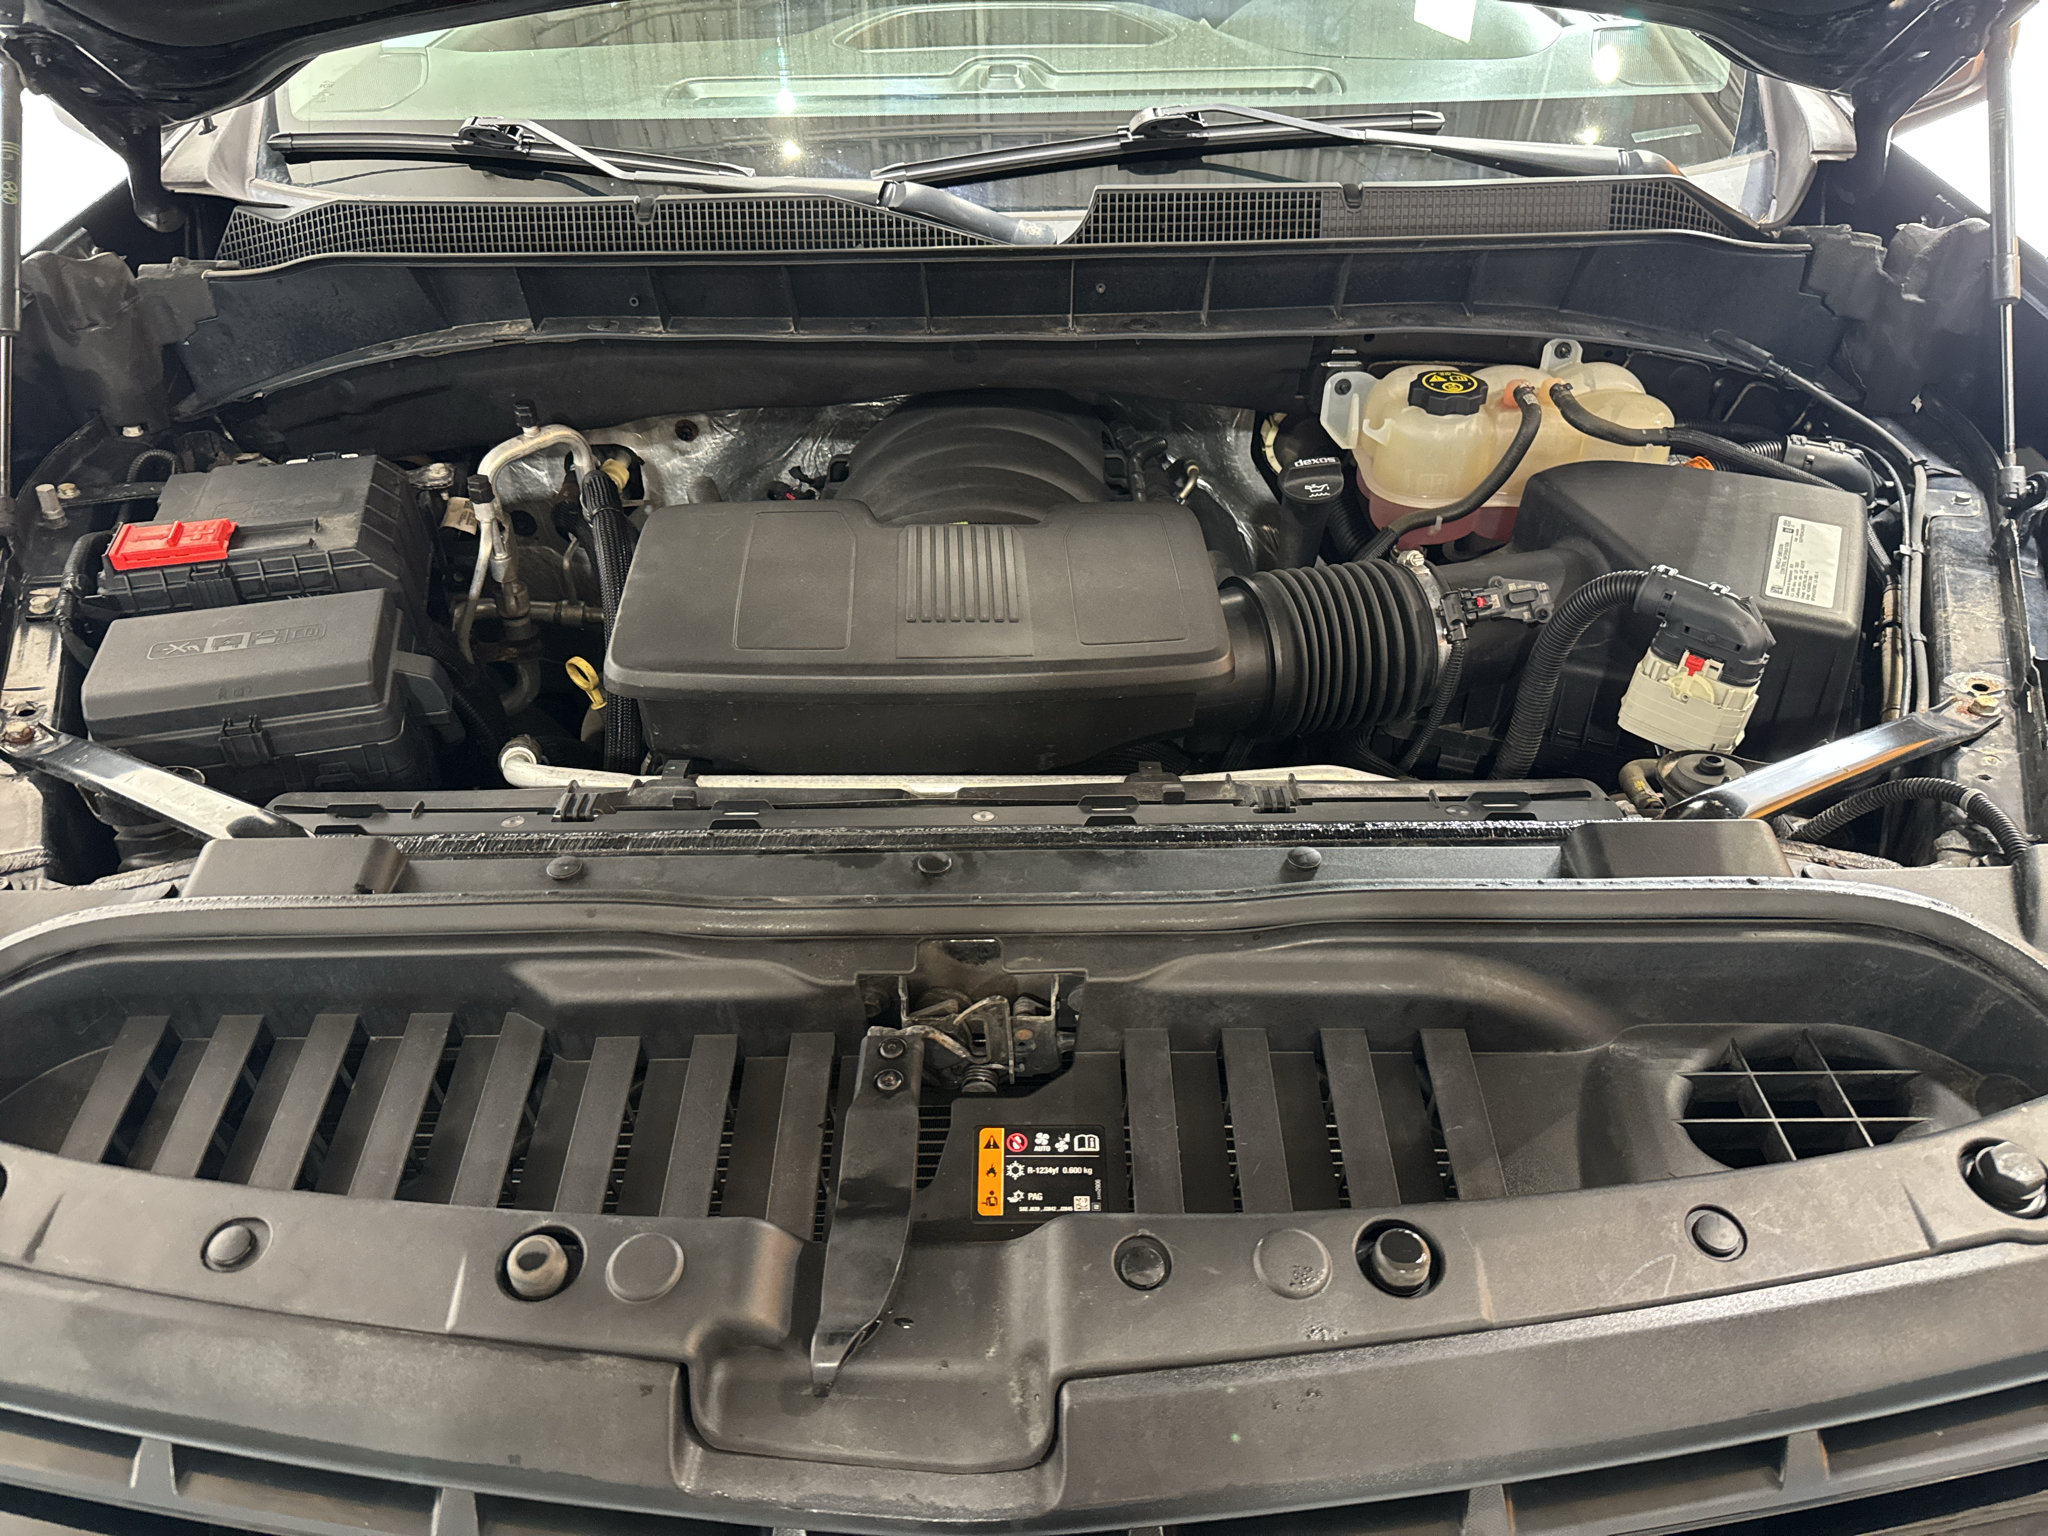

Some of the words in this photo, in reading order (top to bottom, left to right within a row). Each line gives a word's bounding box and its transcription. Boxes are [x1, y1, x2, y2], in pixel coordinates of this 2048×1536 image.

[1294, 457, 1336, 467] dexos
[1027, 1166, 1059, 1175] R-1234yf
[1083, 1166, 1093, 1175] kg
[1027, 1192, 1043, 1201] PAG
